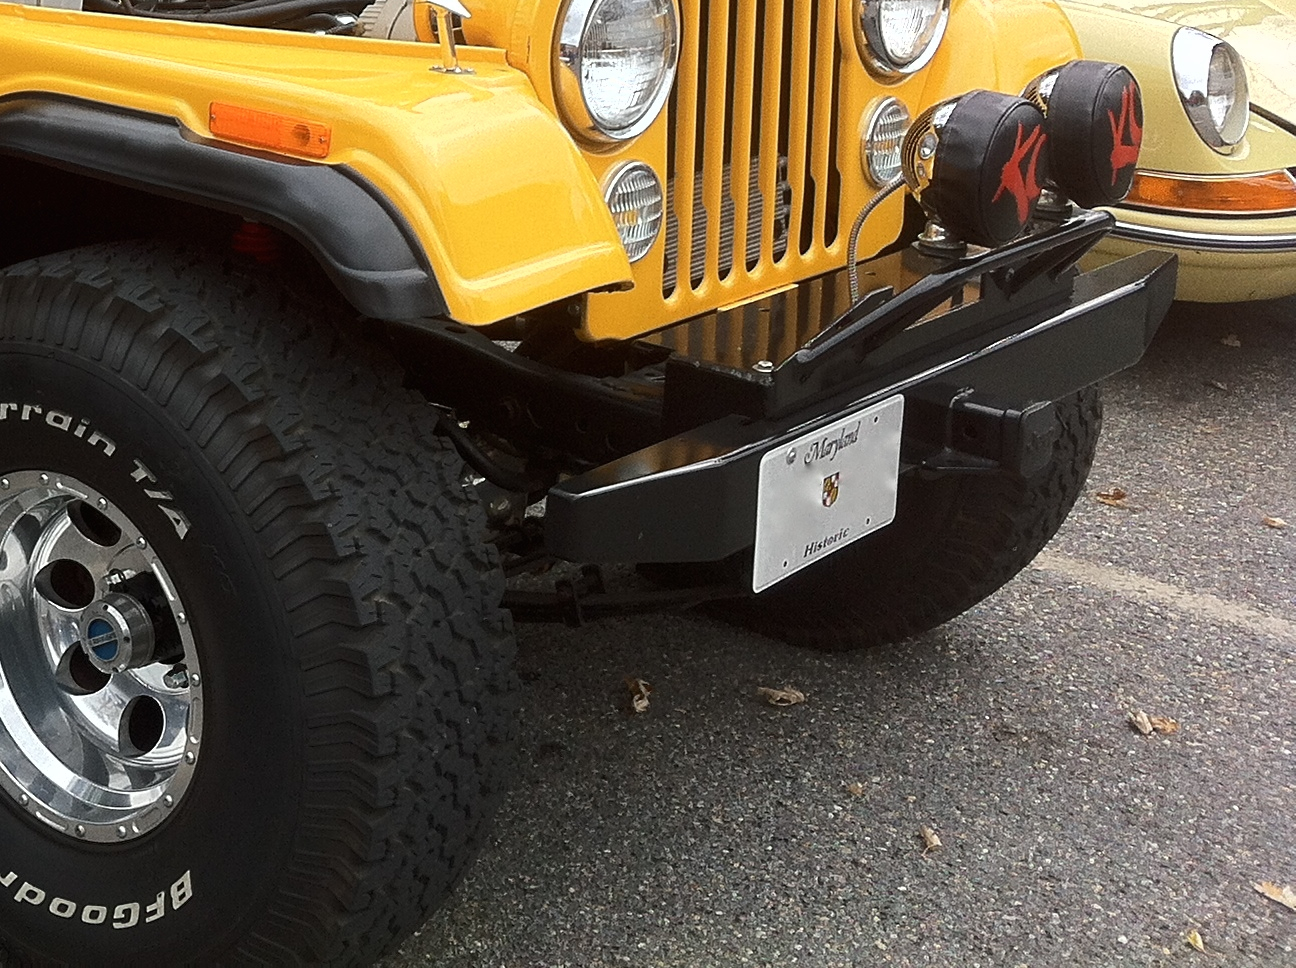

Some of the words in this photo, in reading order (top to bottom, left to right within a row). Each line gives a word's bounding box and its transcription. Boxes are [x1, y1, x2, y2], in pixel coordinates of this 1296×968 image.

[804, 421, 861, 465] Maryland
[129, 457, 193, 541] T/A
[804, 527, 850, 558] Historic
